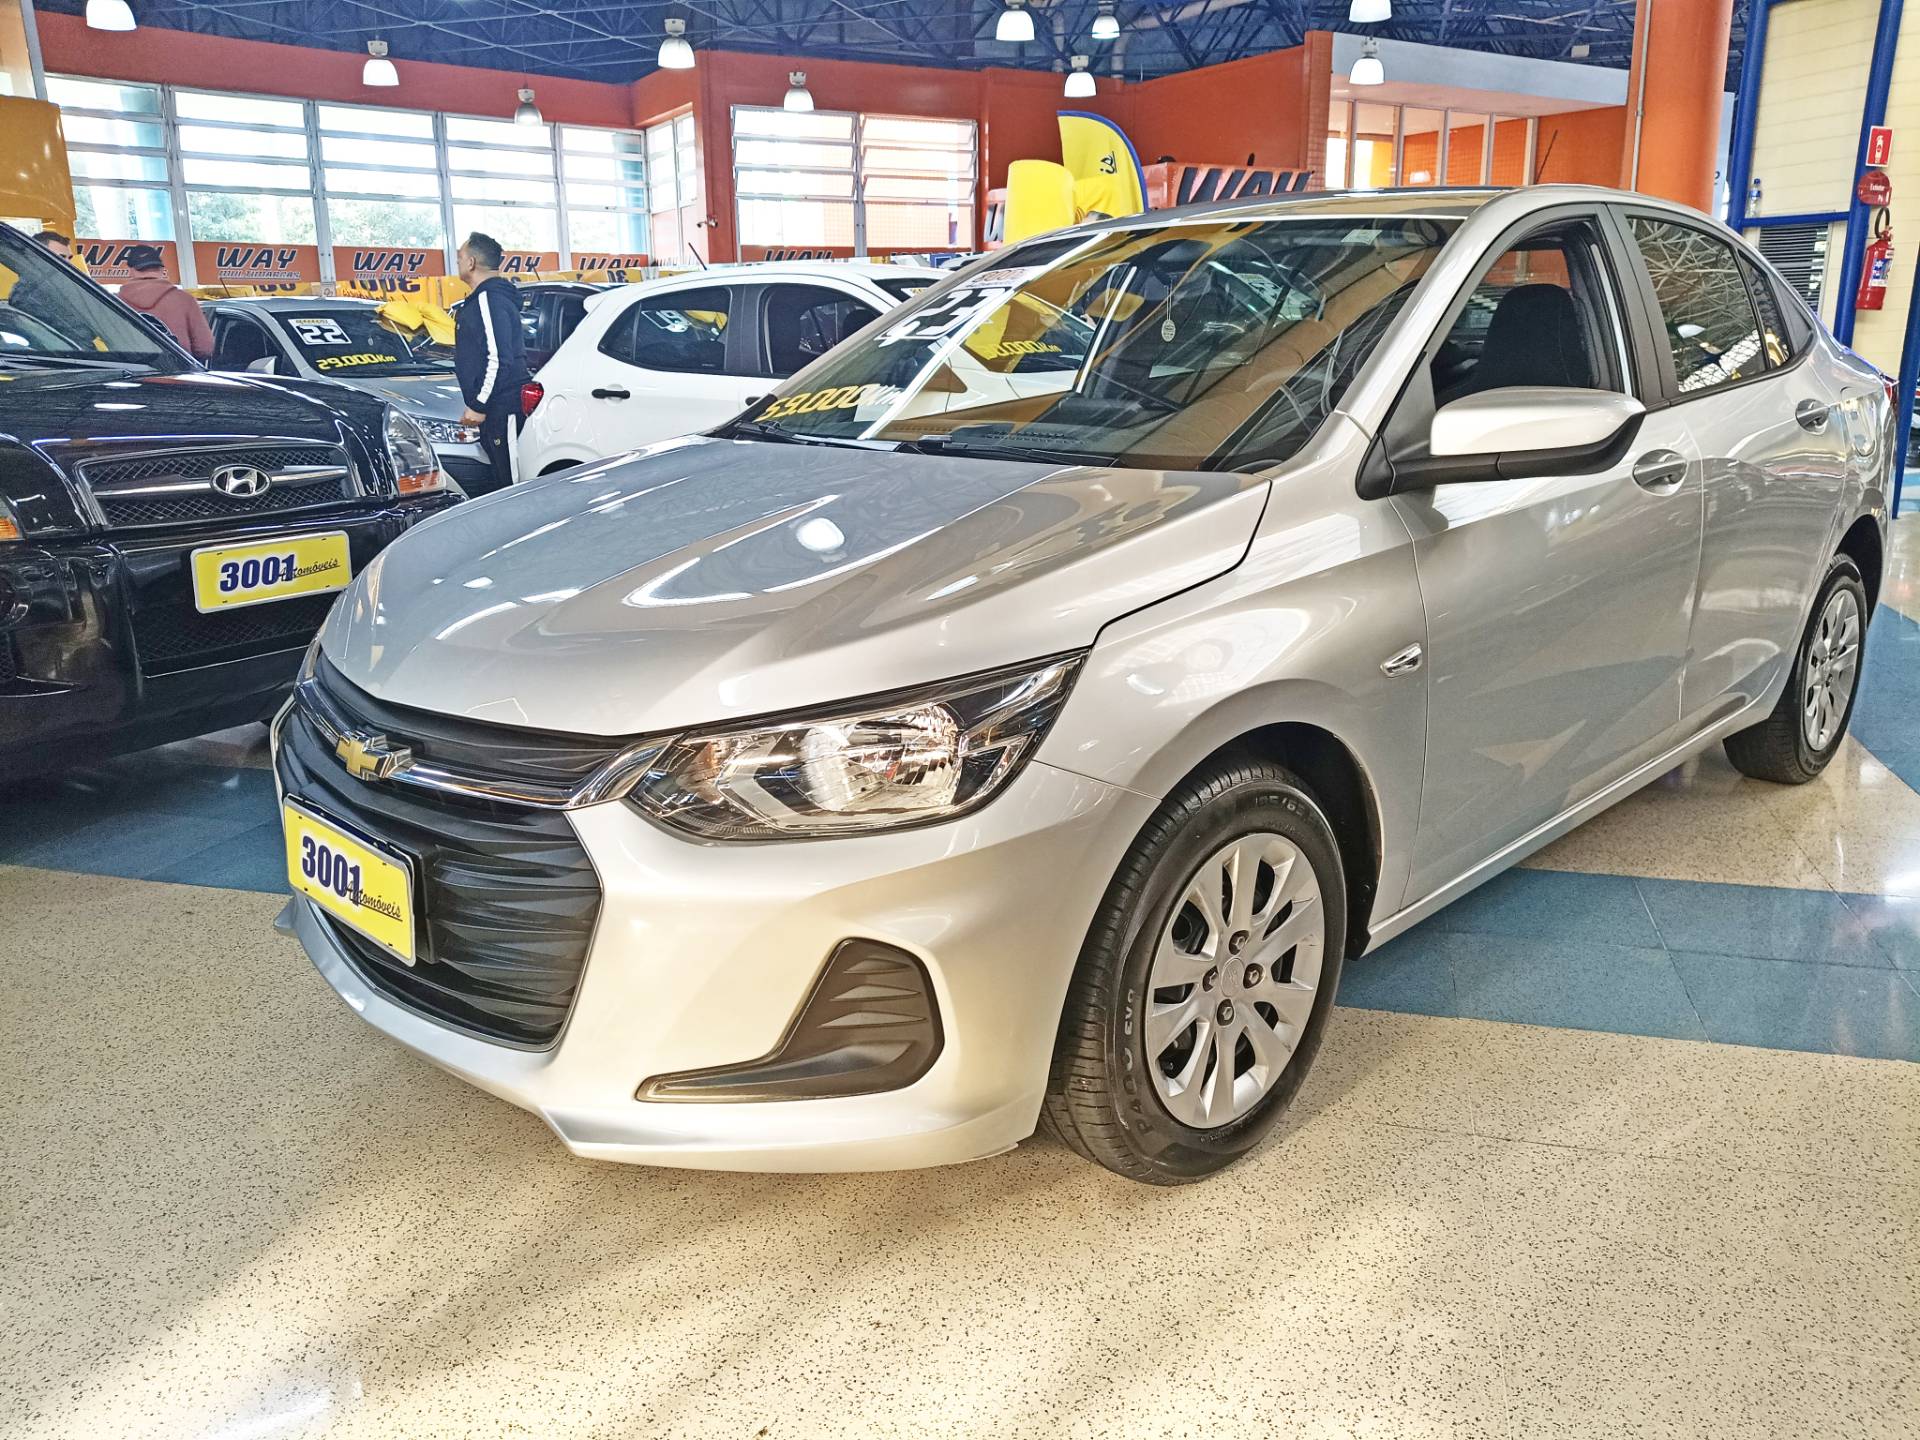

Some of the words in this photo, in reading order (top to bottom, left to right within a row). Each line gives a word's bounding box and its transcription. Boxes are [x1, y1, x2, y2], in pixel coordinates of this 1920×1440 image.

[217, 247, 297, 269] WAY
[353, 251, 426, 272] WAY
[500, 255, 541, 272] AY
[297, 326, 350, 344] 22
[219, 553, 296, 592] 3001
[302, 835, 361, 906] 3001
